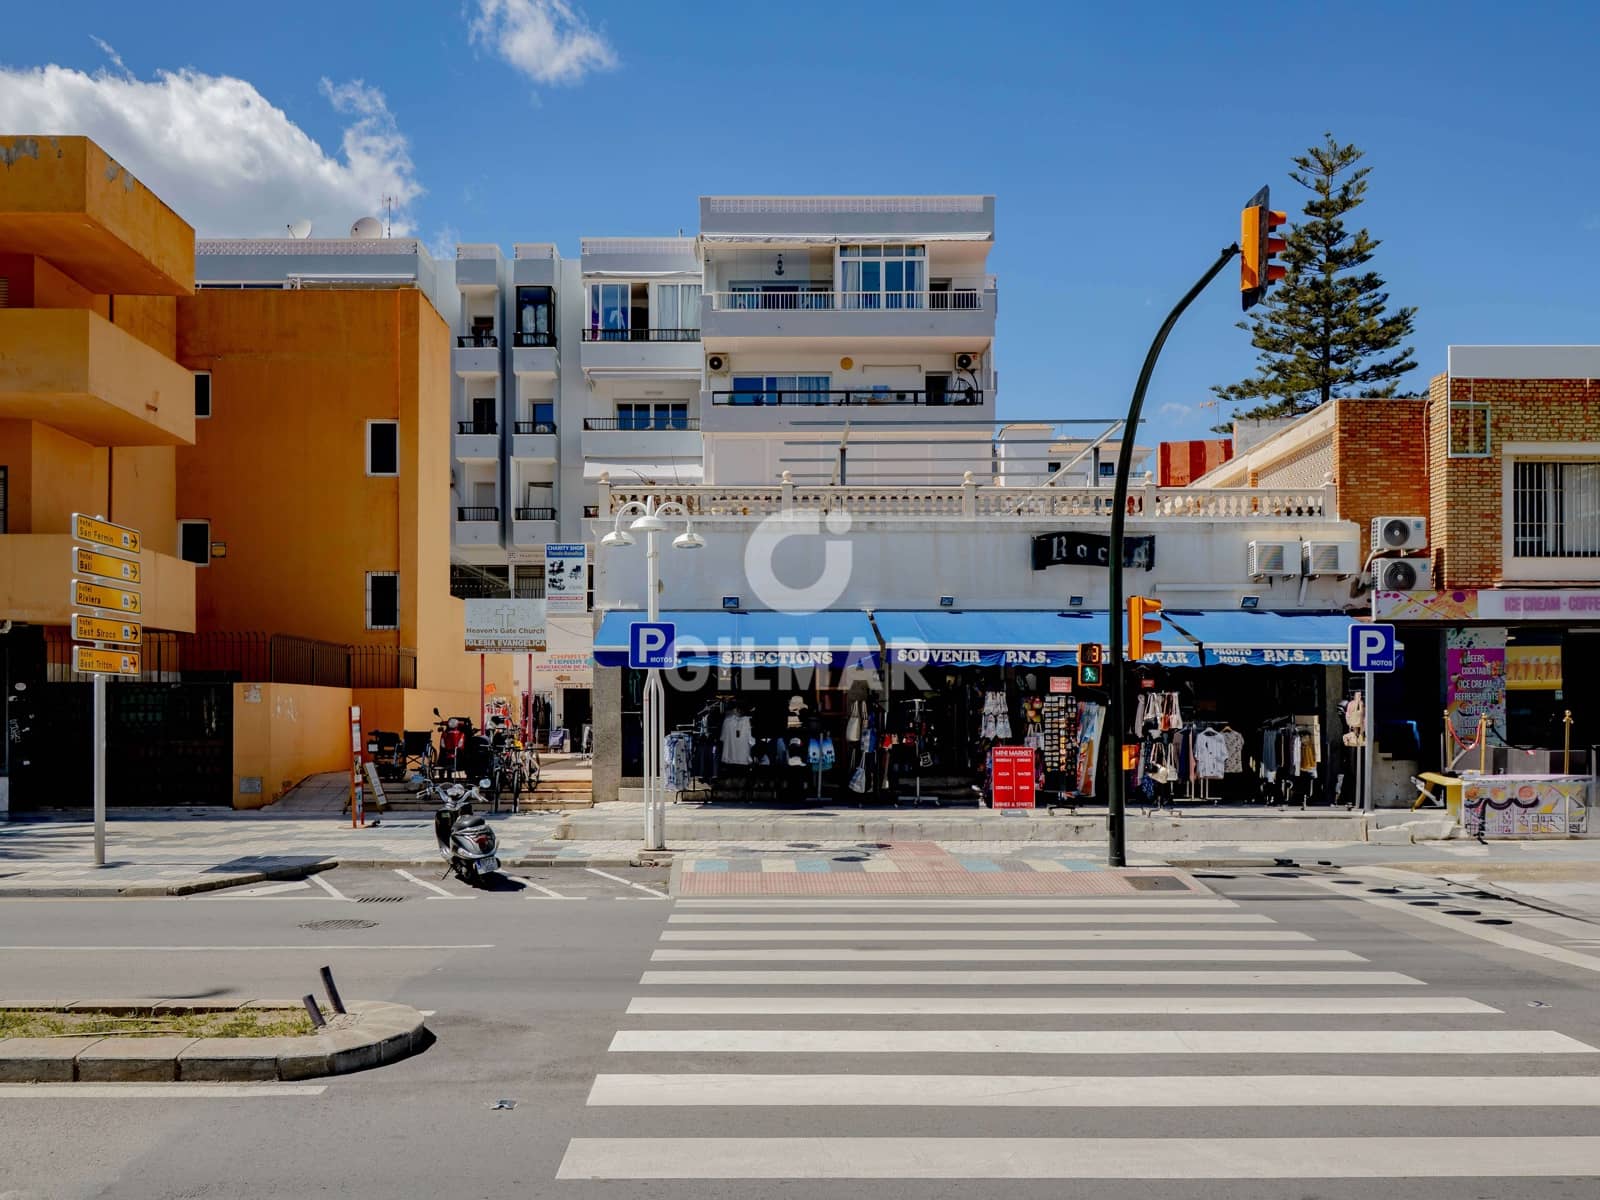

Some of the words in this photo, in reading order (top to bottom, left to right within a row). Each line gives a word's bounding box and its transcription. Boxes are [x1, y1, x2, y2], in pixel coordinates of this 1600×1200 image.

[1504, 596, 1521, 611] ICE
[1523, 596, 1560, 611] CREAM
[639, 627, 666, 663] P
[1213, 648, 1252, 656] PRONTO
[1360, 630, 1386, 666] P
[721, 652, 833, 665] SELECTIONS
[897, 649, 981, 663] SOUVENIR
[1219, 655, 1247, 663] MODA
